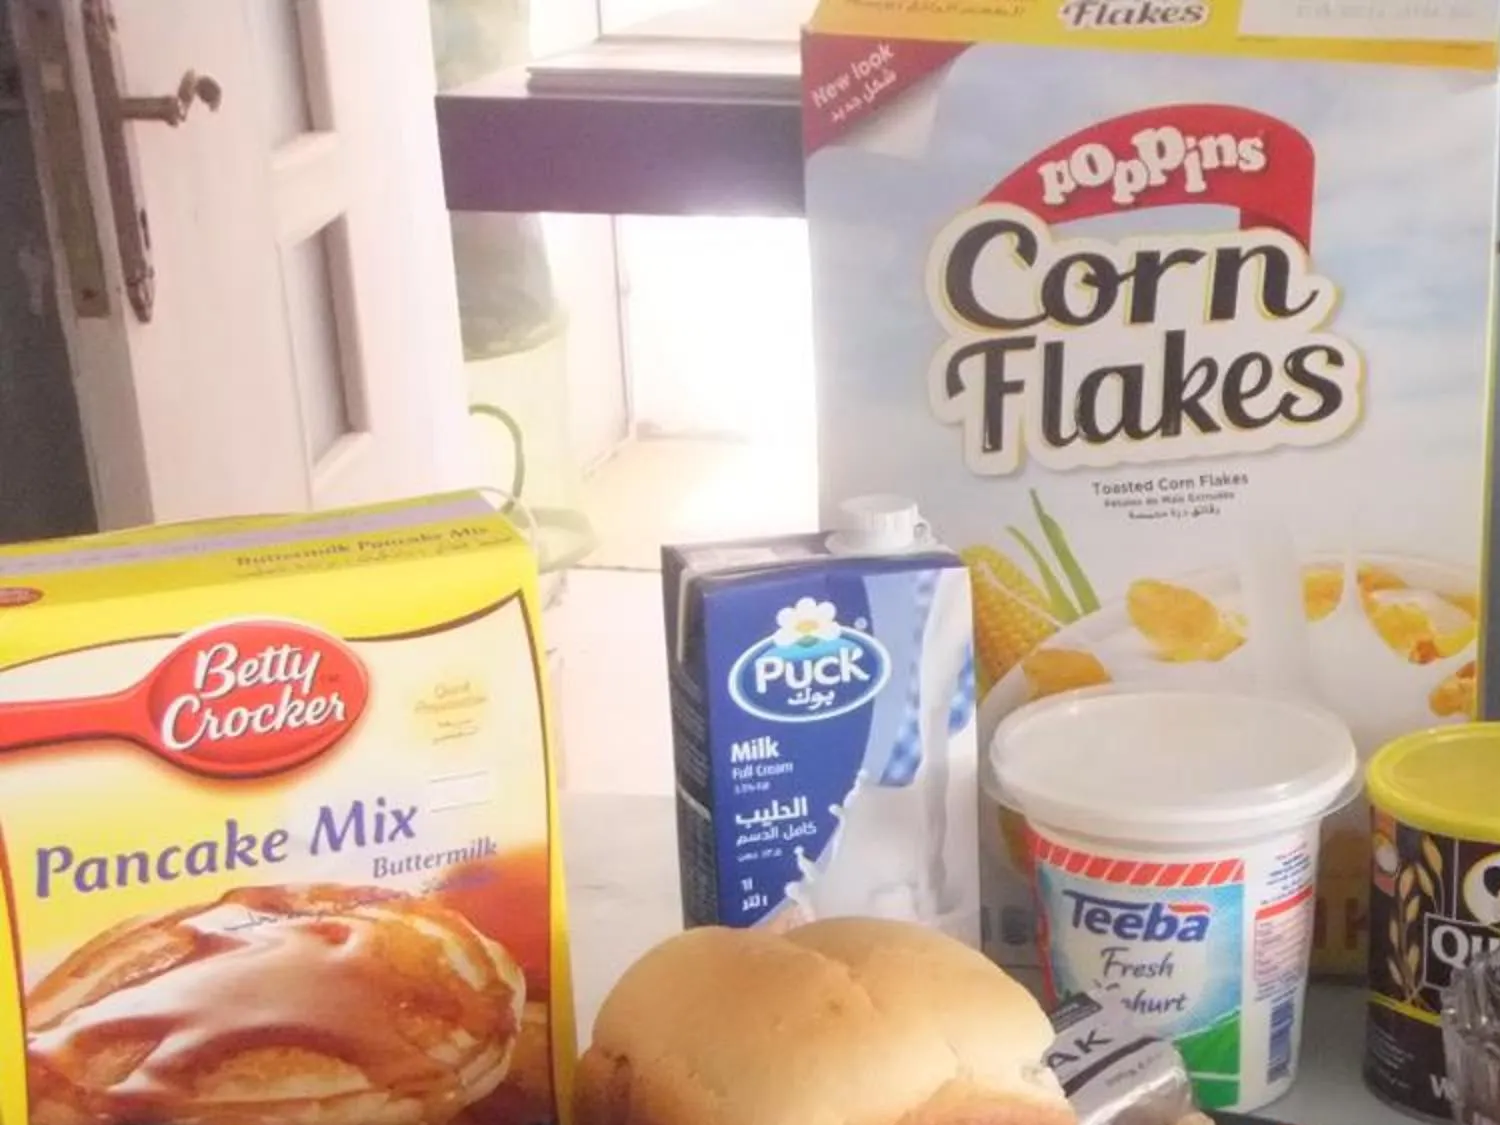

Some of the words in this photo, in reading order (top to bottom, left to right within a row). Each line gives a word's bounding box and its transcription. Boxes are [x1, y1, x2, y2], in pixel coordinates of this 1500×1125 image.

[1062, 0, 1205, 27] Flakes
[811, 72, 852, 109] New
[850, 42, 895, 82] look
[945, 219, 1319, 329] Corn
[945, 330, 1345, 455] Flakes
[1091, 480, 1154, 496] Toasted
[1158, 477, 1195, 491] Corn
[1199, 472, 1250, 487] Flakes
[193, 642, 321, 700] Betty
[755, 647, 871, 694] Puck
[161, 684, 346, 750] Crocker
[787, 686, 836, 711] بوك
[730, 735, 780, 763] Milk
[732, 764, 752, 781] Full
[756, 761, 794, 777] Cream
[735, 796, 808, 829] الحليب
[35, 818, 290, 899] Pancake
[309, 796, 419, 857] Mix
[371, 835, 499, 880] Buttermilk
[1062, 889, 1211, 942] Teeba
[1100, 946, 1176, 979] Fresh
